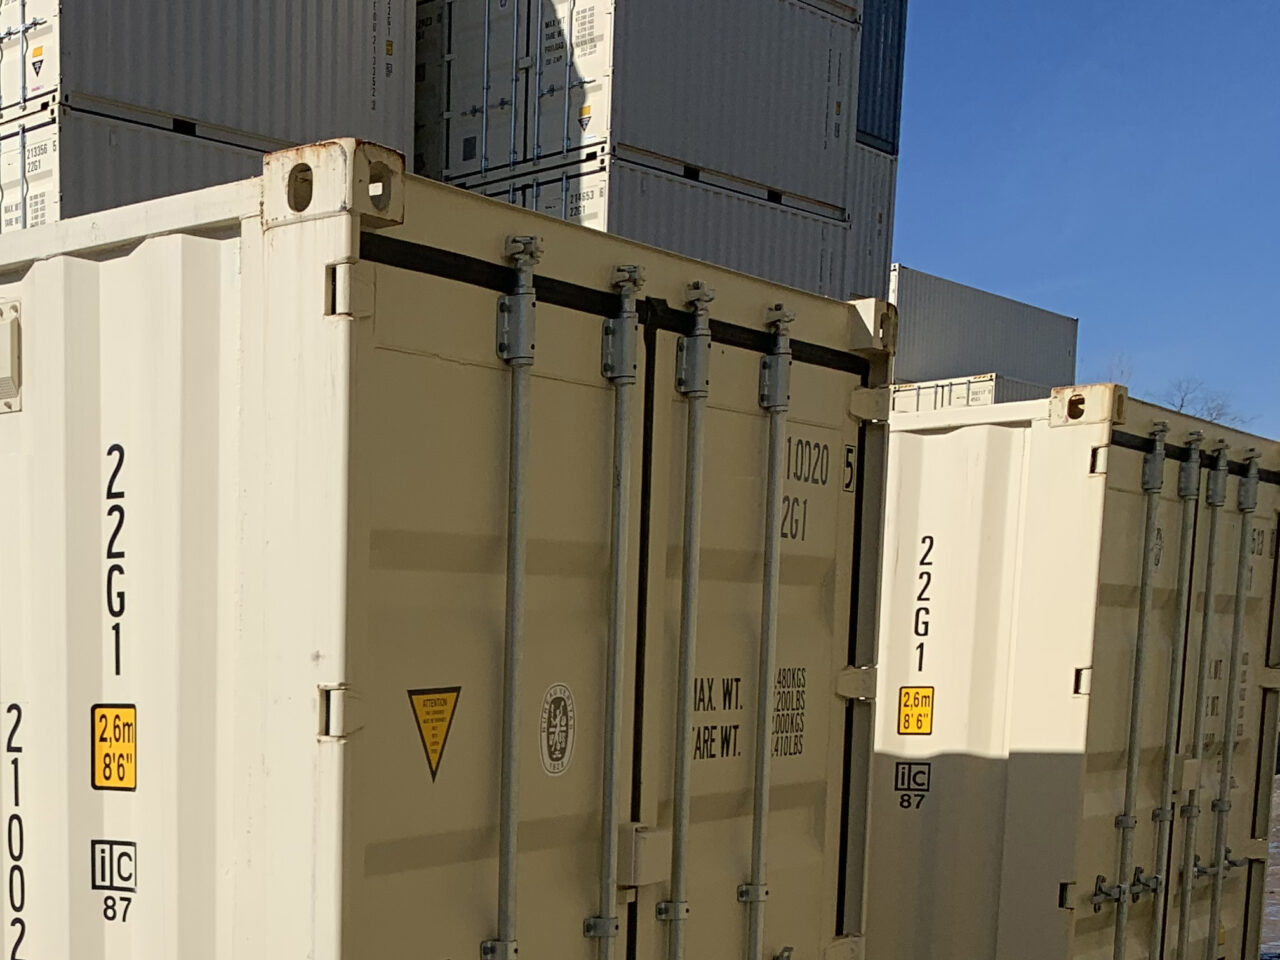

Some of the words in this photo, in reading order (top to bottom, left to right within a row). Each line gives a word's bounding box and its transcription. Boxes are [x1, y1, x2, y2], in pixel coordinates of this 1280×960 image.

[27, 144, 47, 159] 213356
[27, 160, 41, 173] 22G1
[786, 436, 829, 486] 10020
[844, 447, 854, 489] 5
[780, 495, 808, 541] 2G1
[106, 444, 126, 676] 22G1
[914, 535, 934, 672] 22G1
[722, 677, 743, 710] WT.
[903, 691, 931, 711] 2,6m
[98, 713, 134, 748] 2,6m
[693, 725, 717, 760] ARE
[720, 724, 741, 758] WT.
[102, 752, 133, 782] 8'6"
[899, 793, 926, 809] 87
[103, 895, 132, 922] 87
